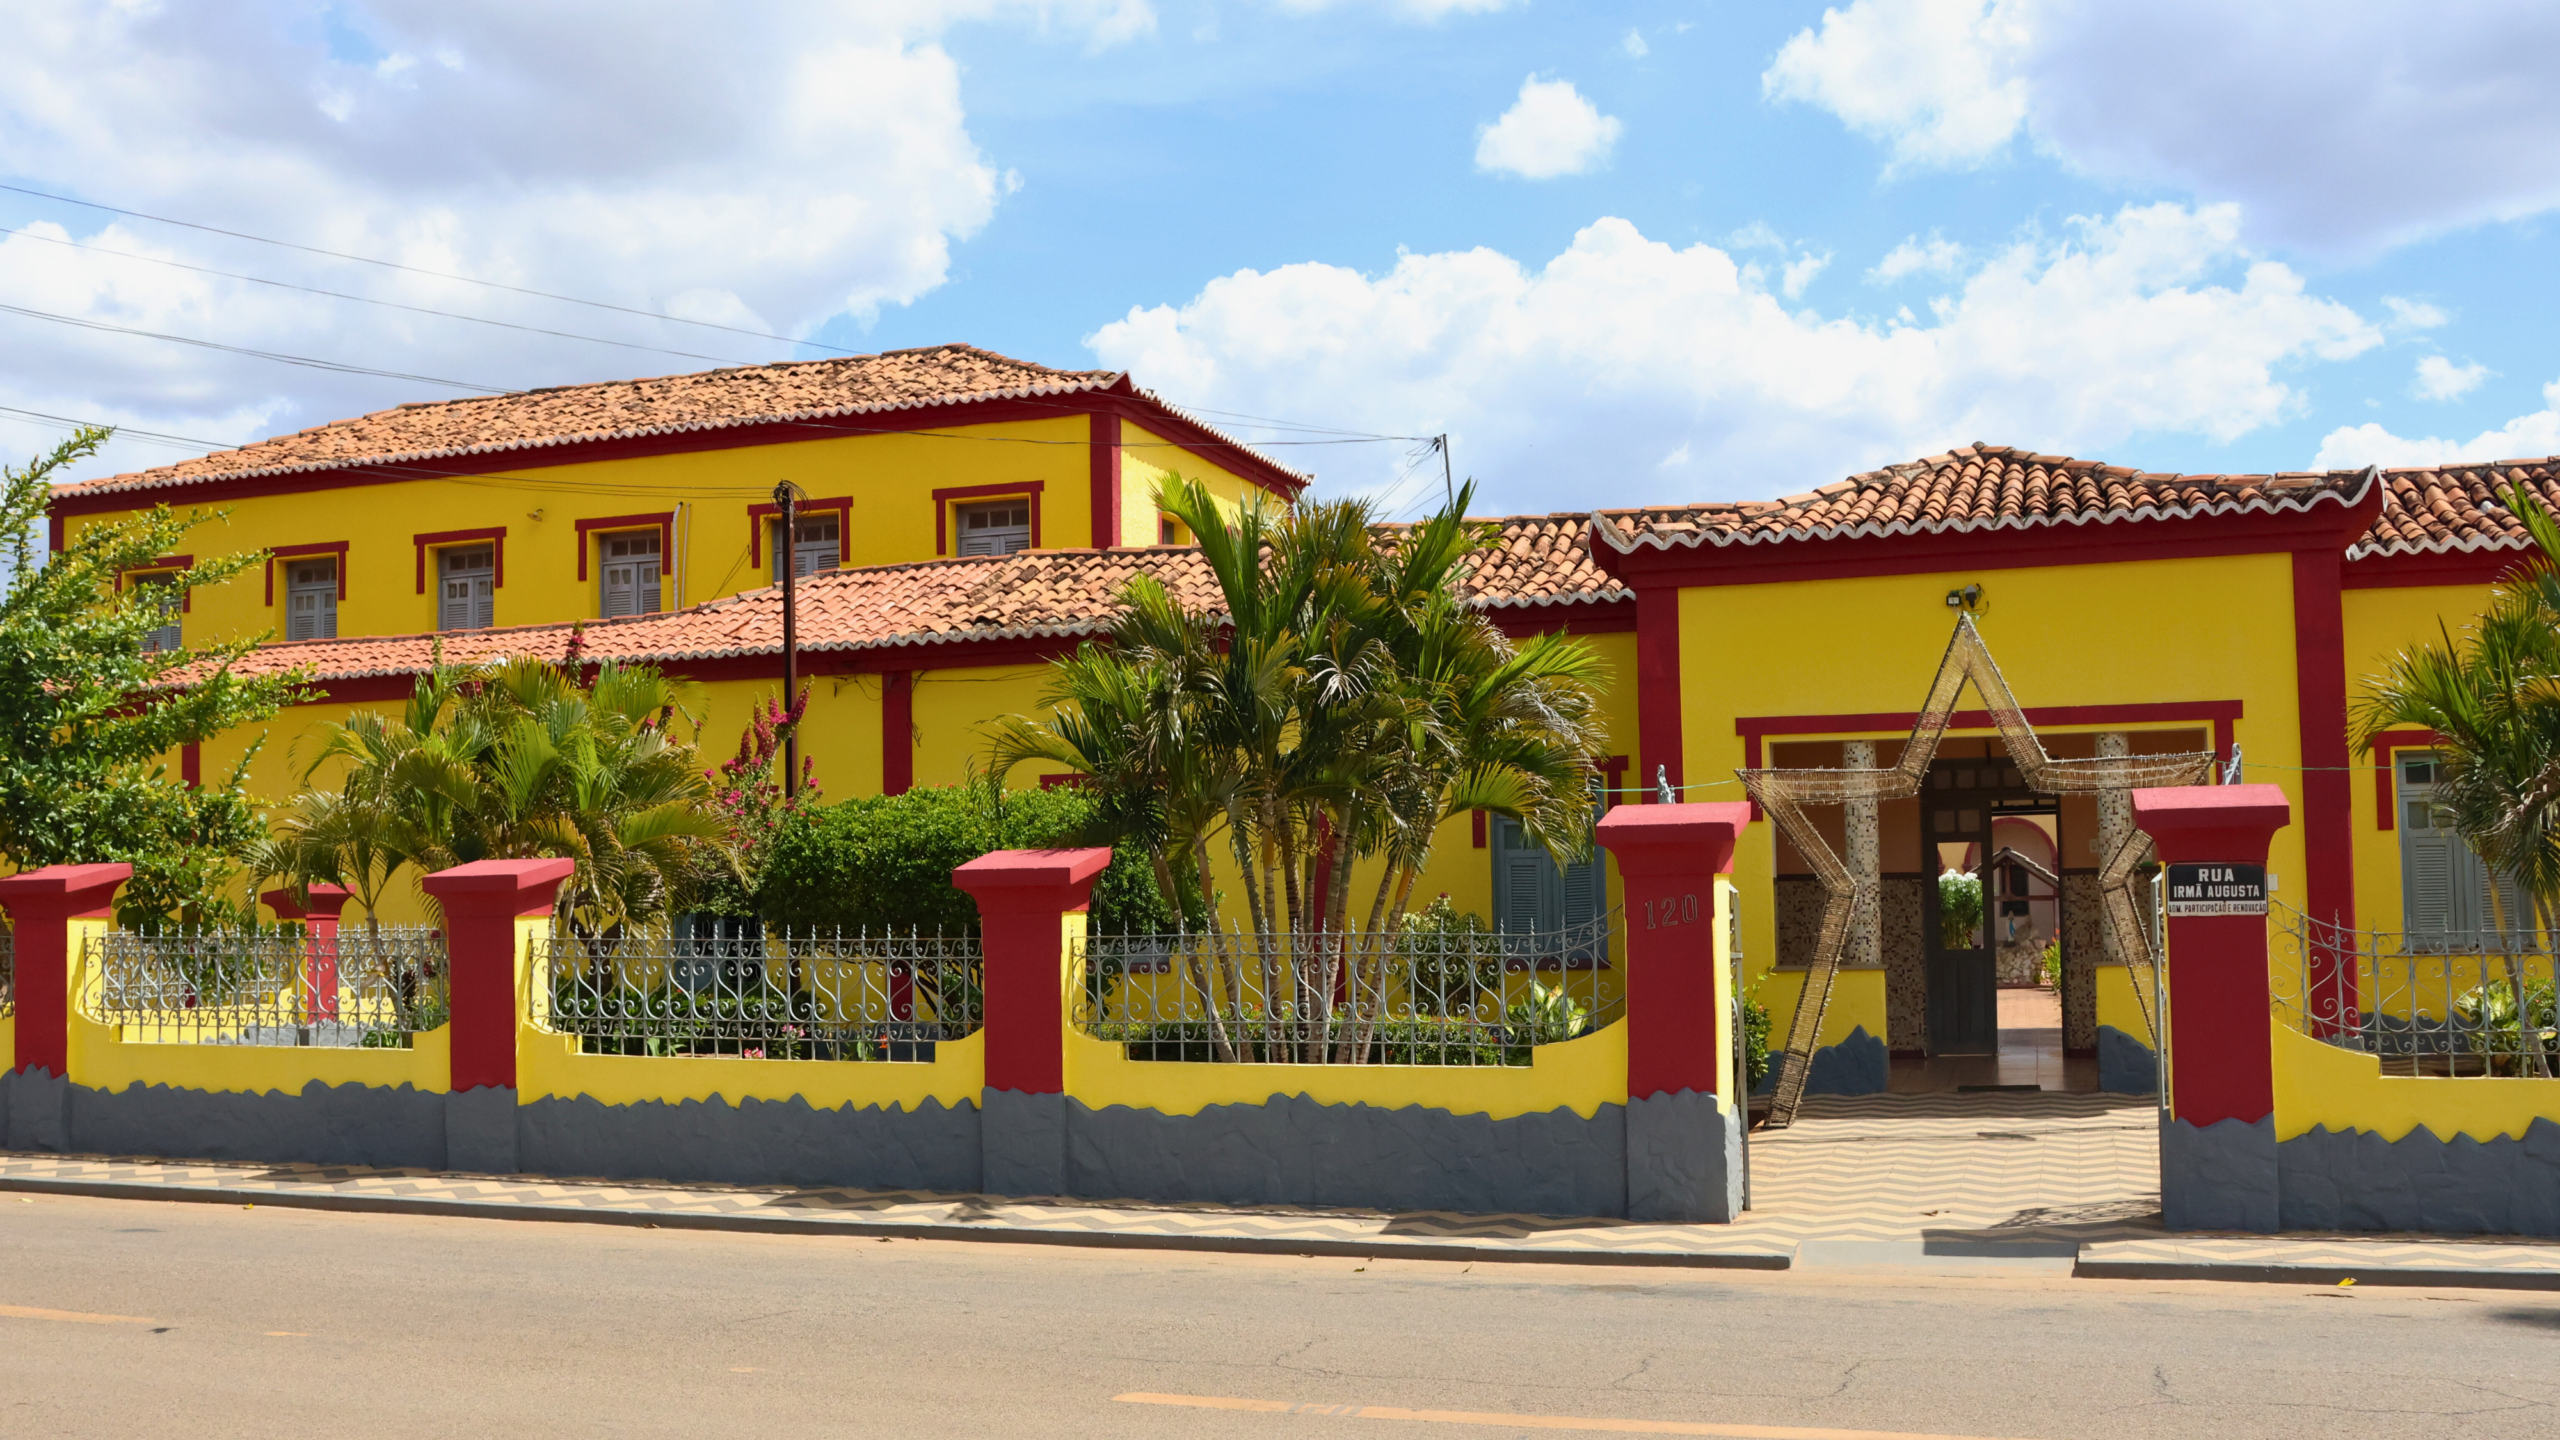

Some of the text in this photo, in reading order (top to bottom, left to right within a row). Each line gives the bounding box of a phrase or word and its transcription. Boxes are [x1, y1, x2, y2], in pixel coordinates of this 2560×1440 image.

[2198, 868, 2235, 882] RUA
[2173, 883, 2260, 898] IRMÃ AUGUSTA
[1644, 893, 1698, 930] 120
[2184, 902, 2227, 913] PARTICIPAÇÃO
[2227, 903, 2232, 913] E
[2233, 902, 2267, 913] RENOVAÇÃO
